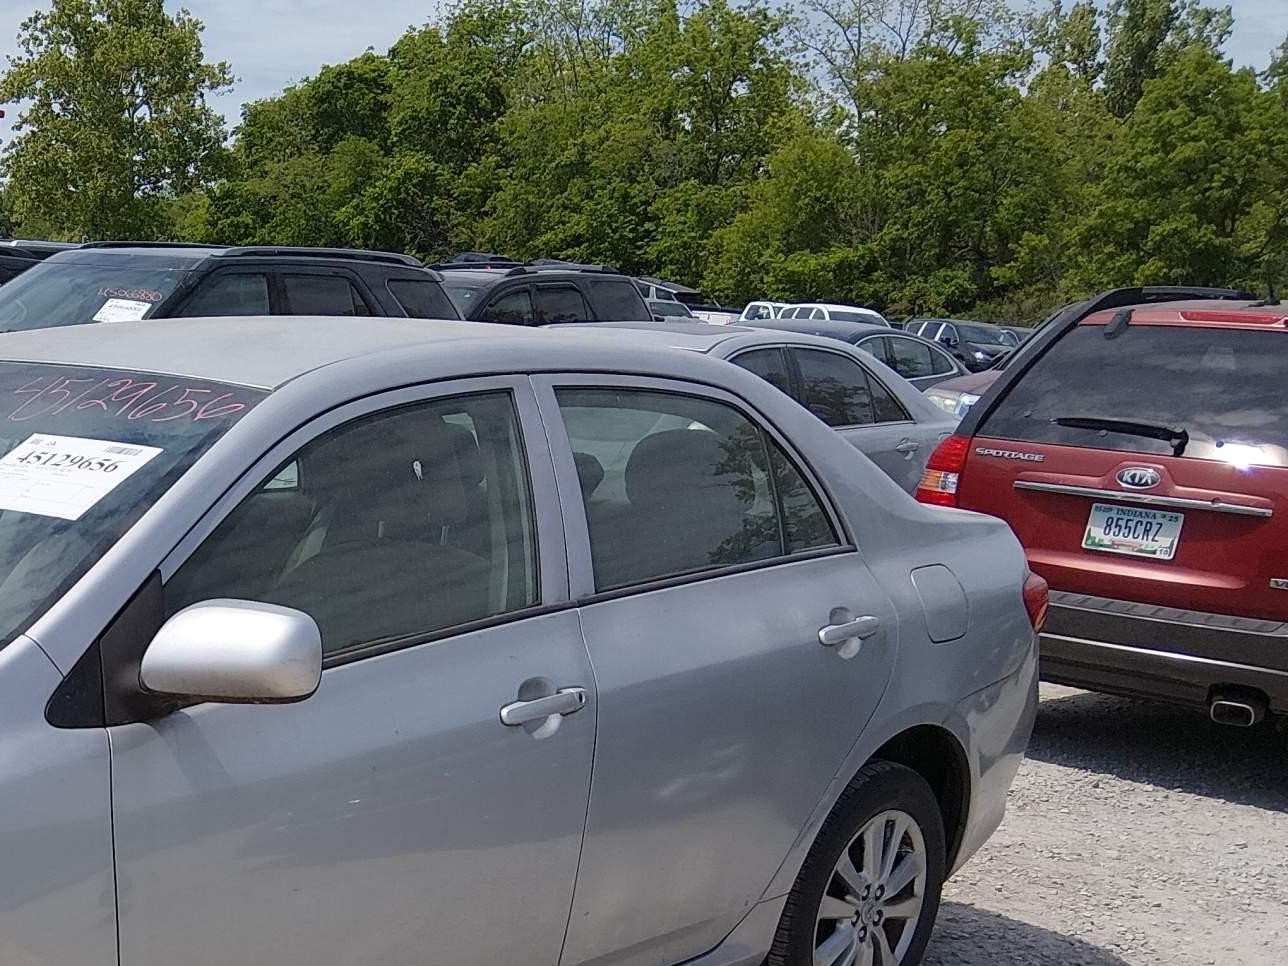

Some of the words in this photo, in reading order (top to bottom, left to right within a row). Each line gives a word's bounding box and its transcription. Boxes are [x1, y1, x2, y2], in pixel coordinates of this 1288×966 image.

[8, 376, 245, 422] 45129656
[17, 450, 126, 473] 45129656
[975, 447, 1045, 462] SPORTAGE
[1122, 469, 1153, 486] KIA
[1116, 507, 1157, 520] INDIANA
[1103, 516, 1163, 543] 855CRZ
